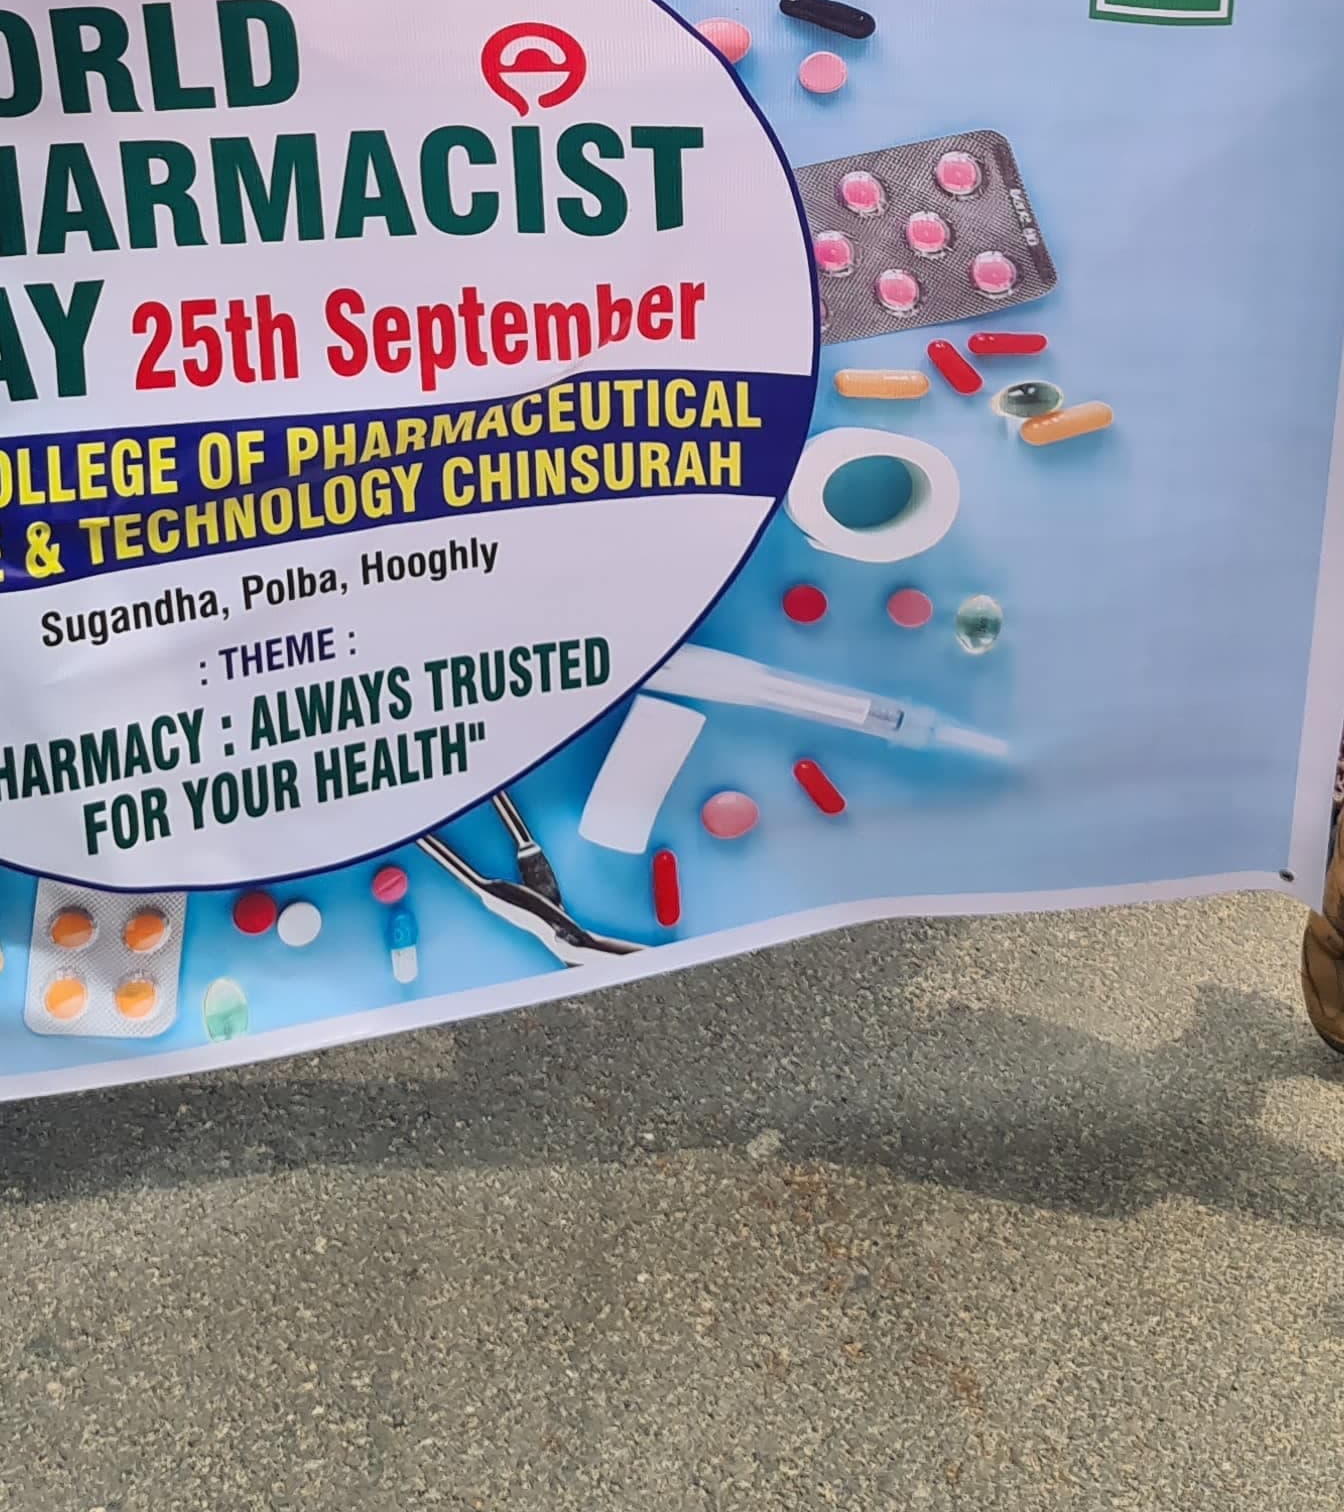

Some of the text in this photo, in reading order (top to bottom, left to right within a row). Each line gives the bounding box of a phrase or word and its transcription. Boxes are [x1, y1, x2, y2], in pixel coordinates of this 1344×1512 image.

[131, 290, 300, 393] 25th
[325, 278, 706, 394] September
[197, 425, 267, 489] OF
[287, 377, 762, 479] PHARMACEUTICAL
[24, 520, 66, 577] &
[80, 468, 422, 566] TECHNOLOGY
[442, 442, 743, 508] CHINSURAH
[41, 537, 500, 647] Sugandha, Polba, Hooghly
[219, 628, 336, 682] THEME
[250, 666, 411, 750] ALWAYS
[424, 635, 611, 711] TRUSTED
[83, 720, 487, 857] FOR YOUR HEALTH"
